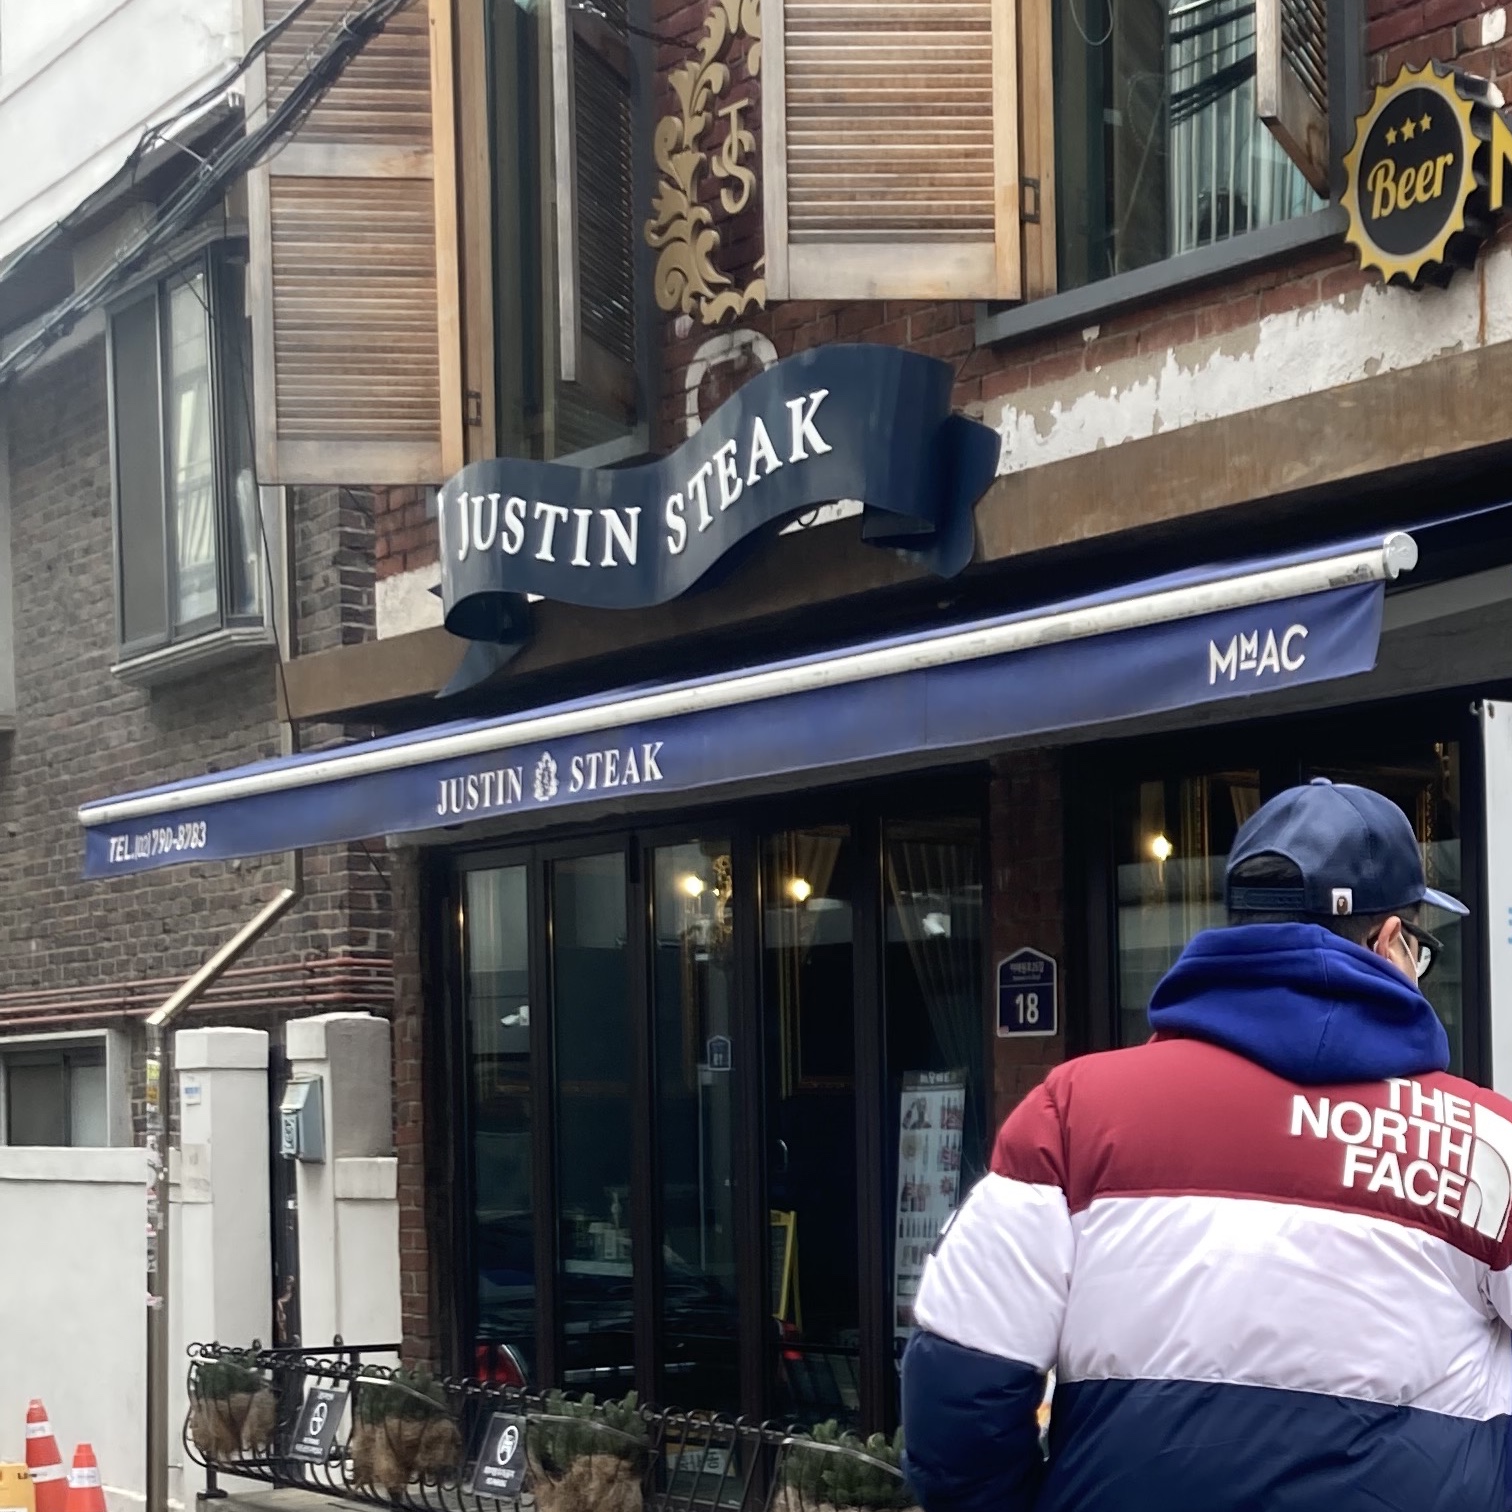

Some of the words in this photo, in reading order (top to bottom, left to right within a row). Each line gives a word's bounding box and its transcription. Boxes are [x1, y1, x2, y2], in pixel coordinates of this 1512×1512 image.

[1367, 151, 1453, 220] Beer
[457, 491, 641, 567] JUSTIN
[666, 389, 832, 556] STEAK
[437, 767, 523, 815] JUSTIN
[569, 742, 664, 793] STEAK
[1015, 992, 1039, 1024] 18
[1290, 1094, 1472, 1176] NORTH
[1386, 1077, 1472, 1134] THE
[1342, 1144, 1466, 1218] FACE
